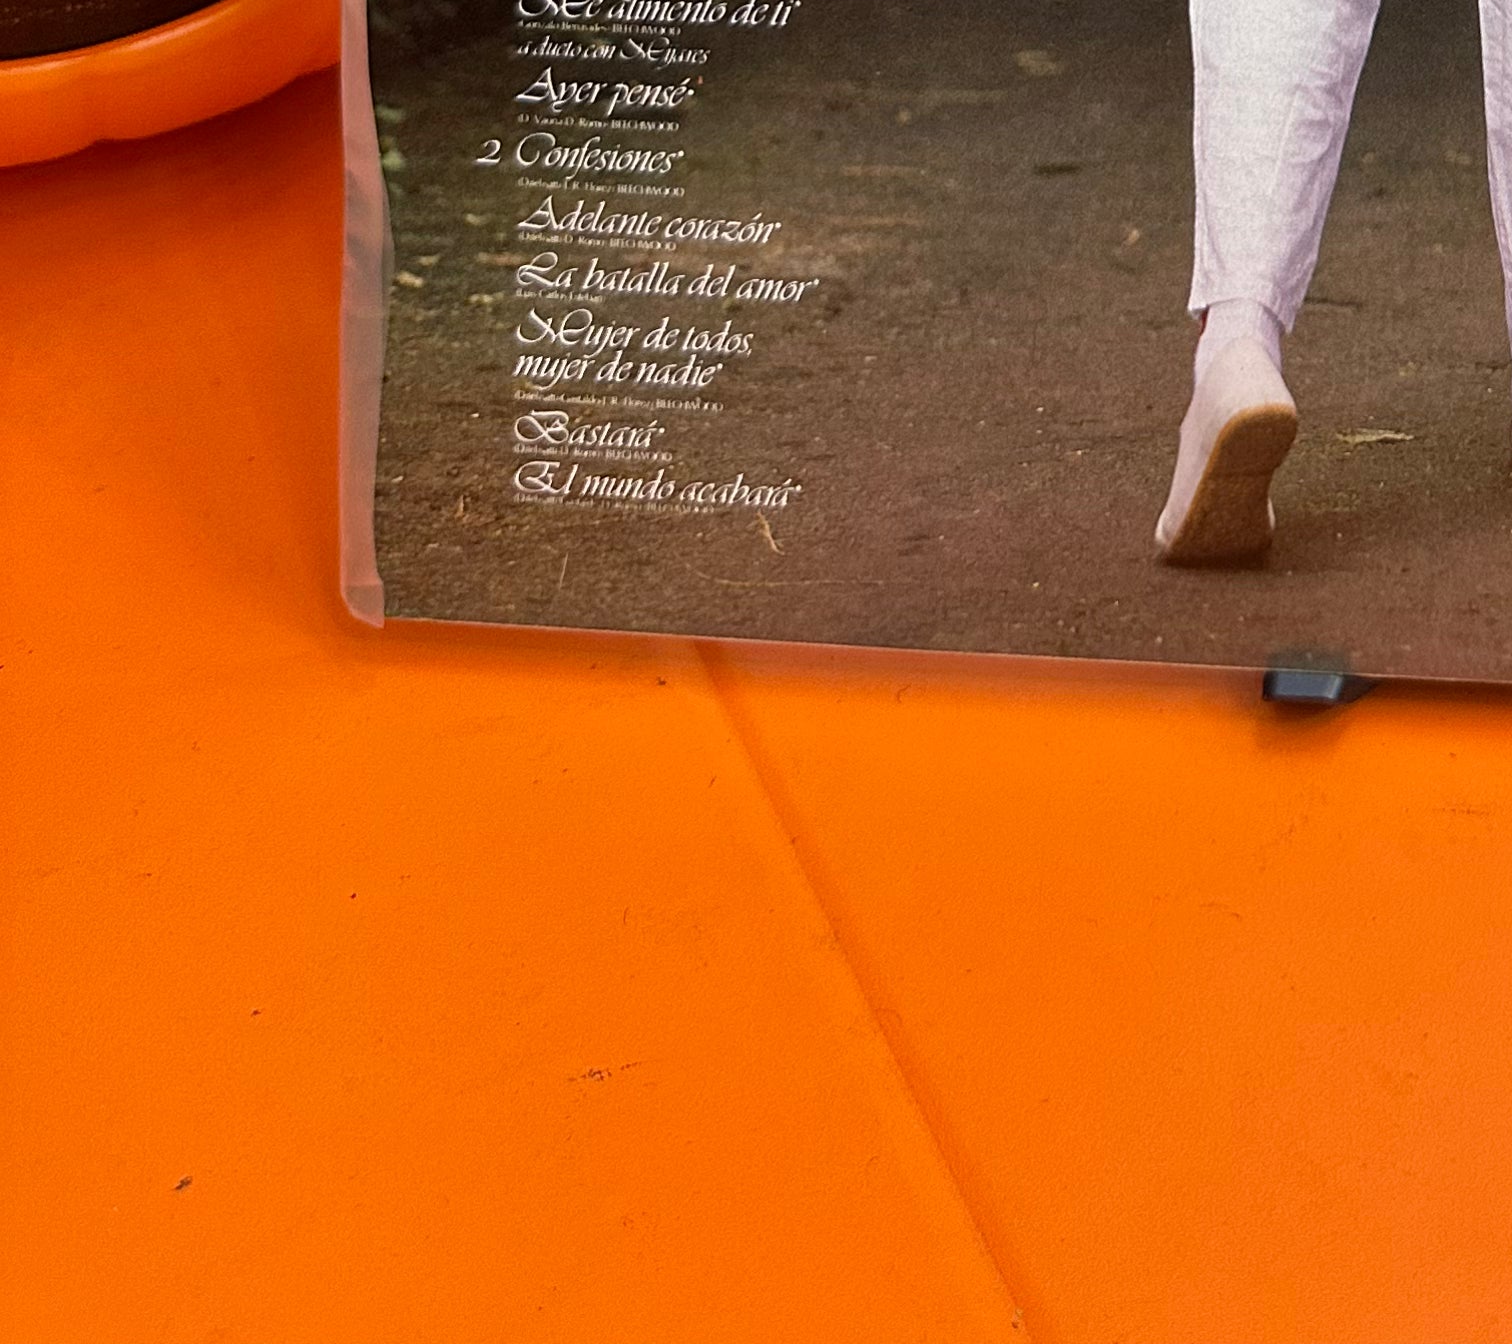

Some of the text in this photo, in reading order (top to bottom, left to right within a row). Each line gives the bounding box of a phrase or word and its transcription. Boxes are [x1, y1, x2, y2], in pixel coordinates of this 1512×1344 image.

[583, 41, 617, 61] con
[514, 66, 692, 117] Ayer pensé
[476, 131, 678, 180] 2 Confesiones
[517, 194, 660, 237] Adelante
[663, 212, 776, 245] corazón
[515, 251, 579, 289] La
[581, 257, 687, 296] batalla
[687, 263, 737, 297] del
[735, 277, 814, 303] amor
[515, 307, 642, 356] Mujer
[642, 315, 681, 351] de
[511, 350, 717, 391] mujer de nadie
[513, 409, 659, 449] Bastará
[512, 460, 580, 496] El
[578, 467, 676, 500] mundo
[679, 472, 793, 508] acabará
